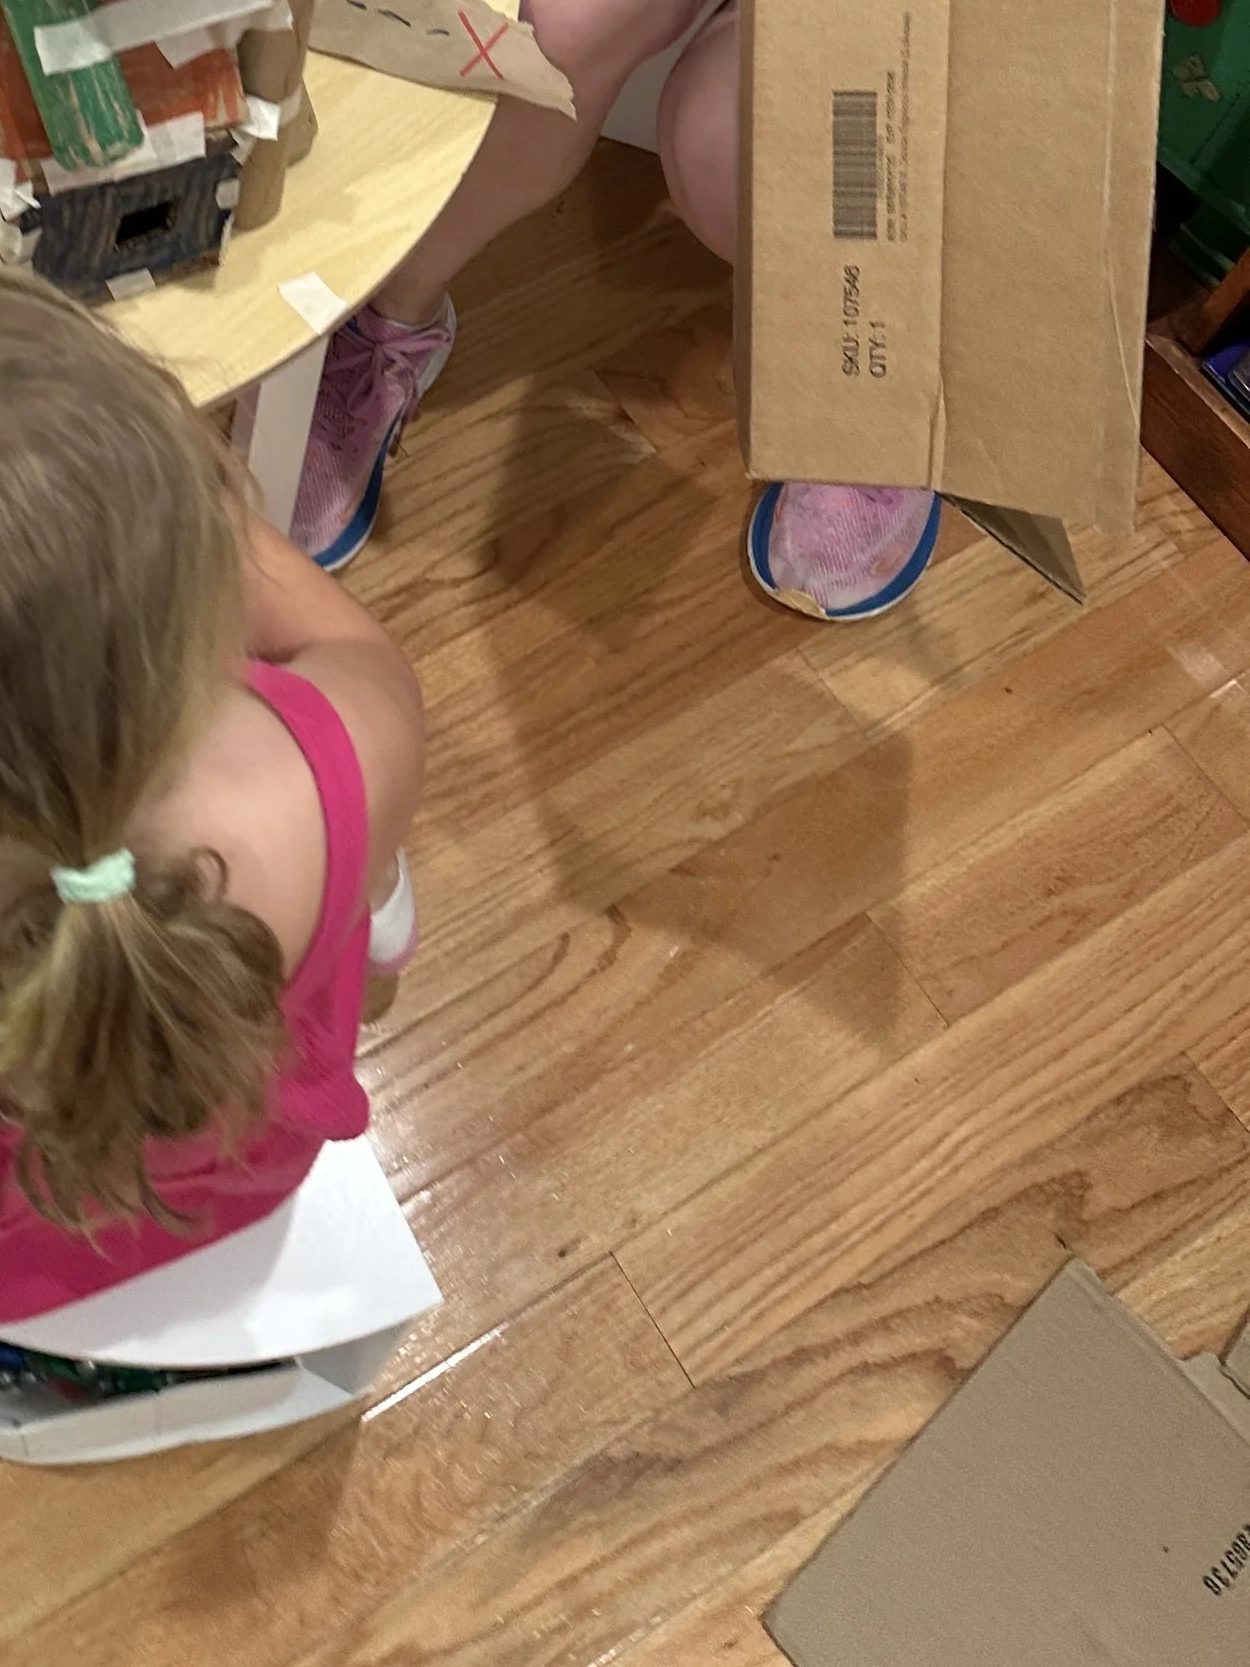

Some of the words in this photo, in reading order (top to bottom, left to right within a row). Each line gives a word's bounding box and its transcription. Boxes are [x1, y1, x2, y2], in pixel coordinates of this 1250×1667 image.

[868, 319, 886, 329] 1
[842, 332, 860, 376] SKU:
[868, 332, 887, 378] QTY:
